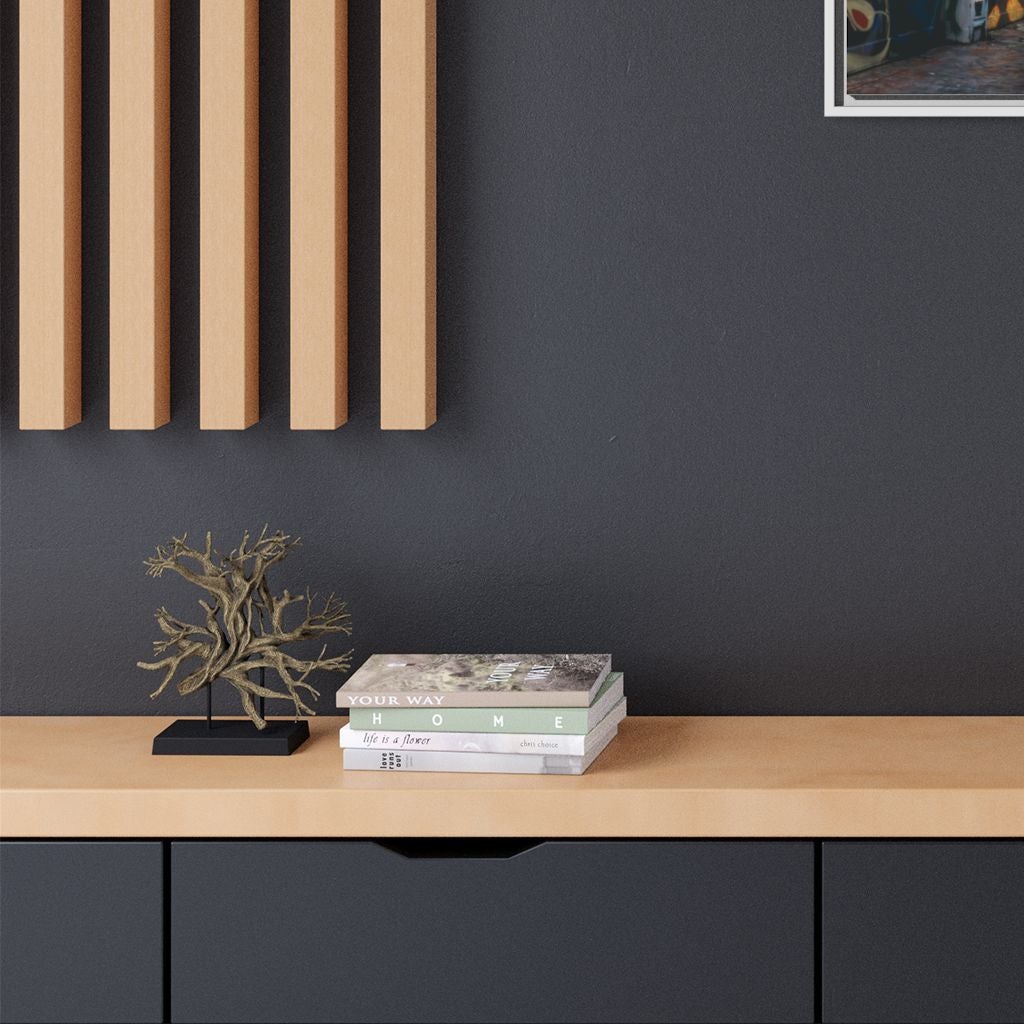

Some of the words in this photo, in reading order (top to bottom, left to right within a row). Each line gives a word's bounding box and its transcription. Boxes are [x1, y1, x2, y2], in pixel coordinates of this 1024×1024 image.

[348, 696, 400, 705] YOUR
[407, 696, 445, 705] WAY
[363, 733, 379, 746] life
[382, 735, 390, 743] is
[400, 734, 431, 747] flower
